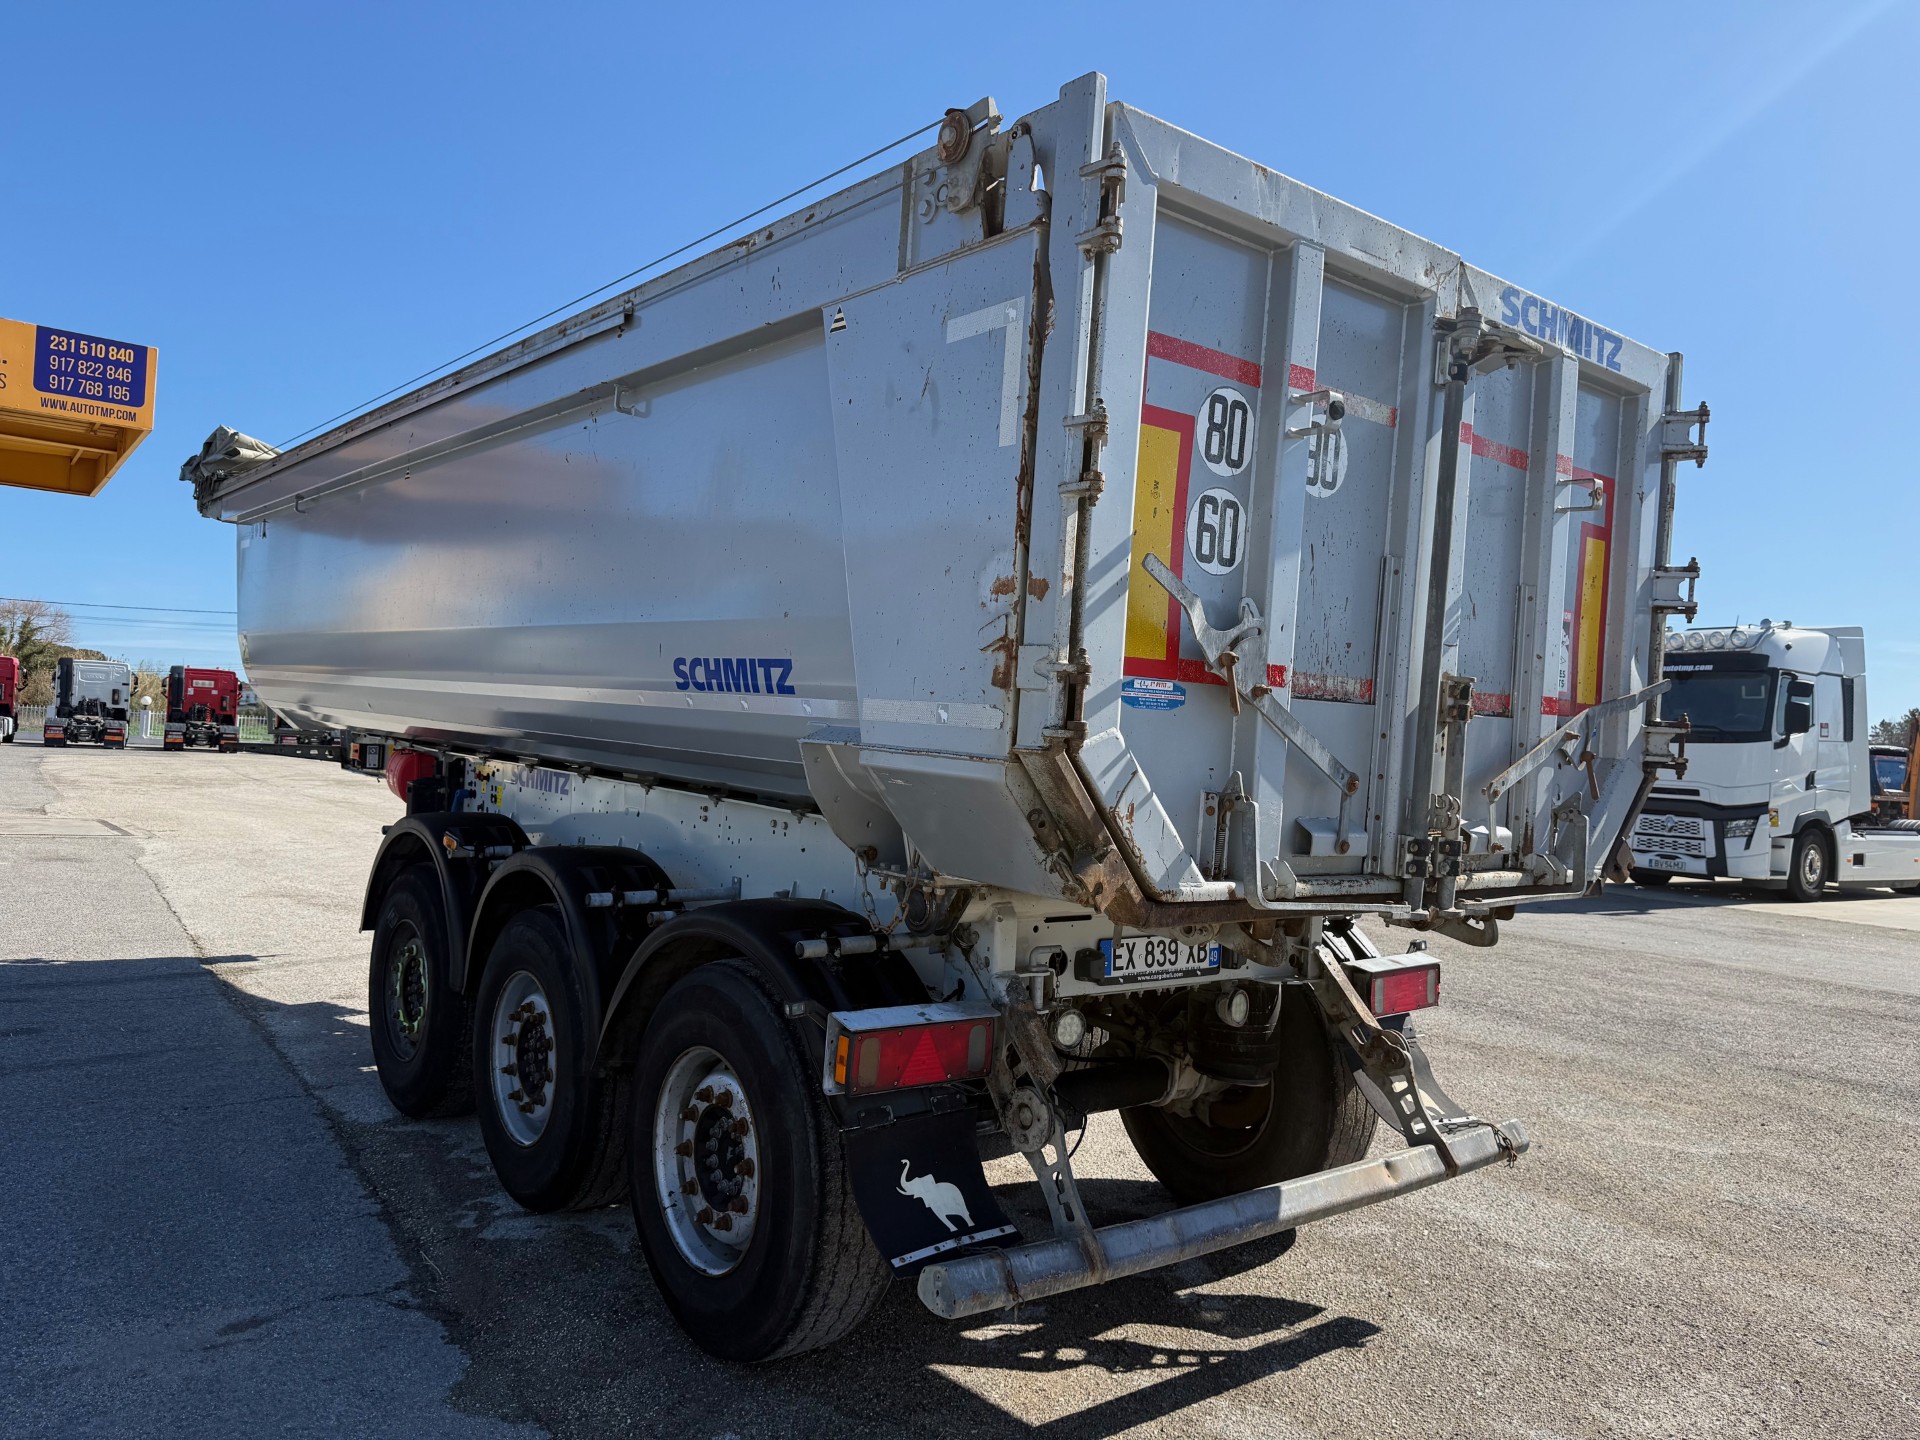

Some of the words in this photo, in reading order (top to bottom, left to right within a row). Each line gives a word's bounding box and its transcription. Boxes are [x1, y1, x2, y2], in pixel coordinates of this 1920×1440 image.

[1501, 286, 1624, 372] SCHMITZ
[49, 335, 76, 353] 231
[79, 340, 106, 358] 510
[108, 346, 134, 363] 840
[49, 355, 75, 373] 917
[77, 360, 104, 378] 822
[106, 365, 132, 383] 846
[49, 374, 75, 392] 917
[78, 379, 103, 397] 768
[107, 384, 130, 401] 195
[40, 397, 137, 422] WWW.AUTOTMP.COM
[1204, 393, 1248, 470] 80
[1195, 494, 1240, 568] 60
[673, 657, 796, 695] SCHMITZ
[511, 765, 571, 796] SCHMITZ
[1112, 941, 1137, 972] EX
[1144, 939, 1179, 969] 839
[1209, 950, 1218, 962] 49
